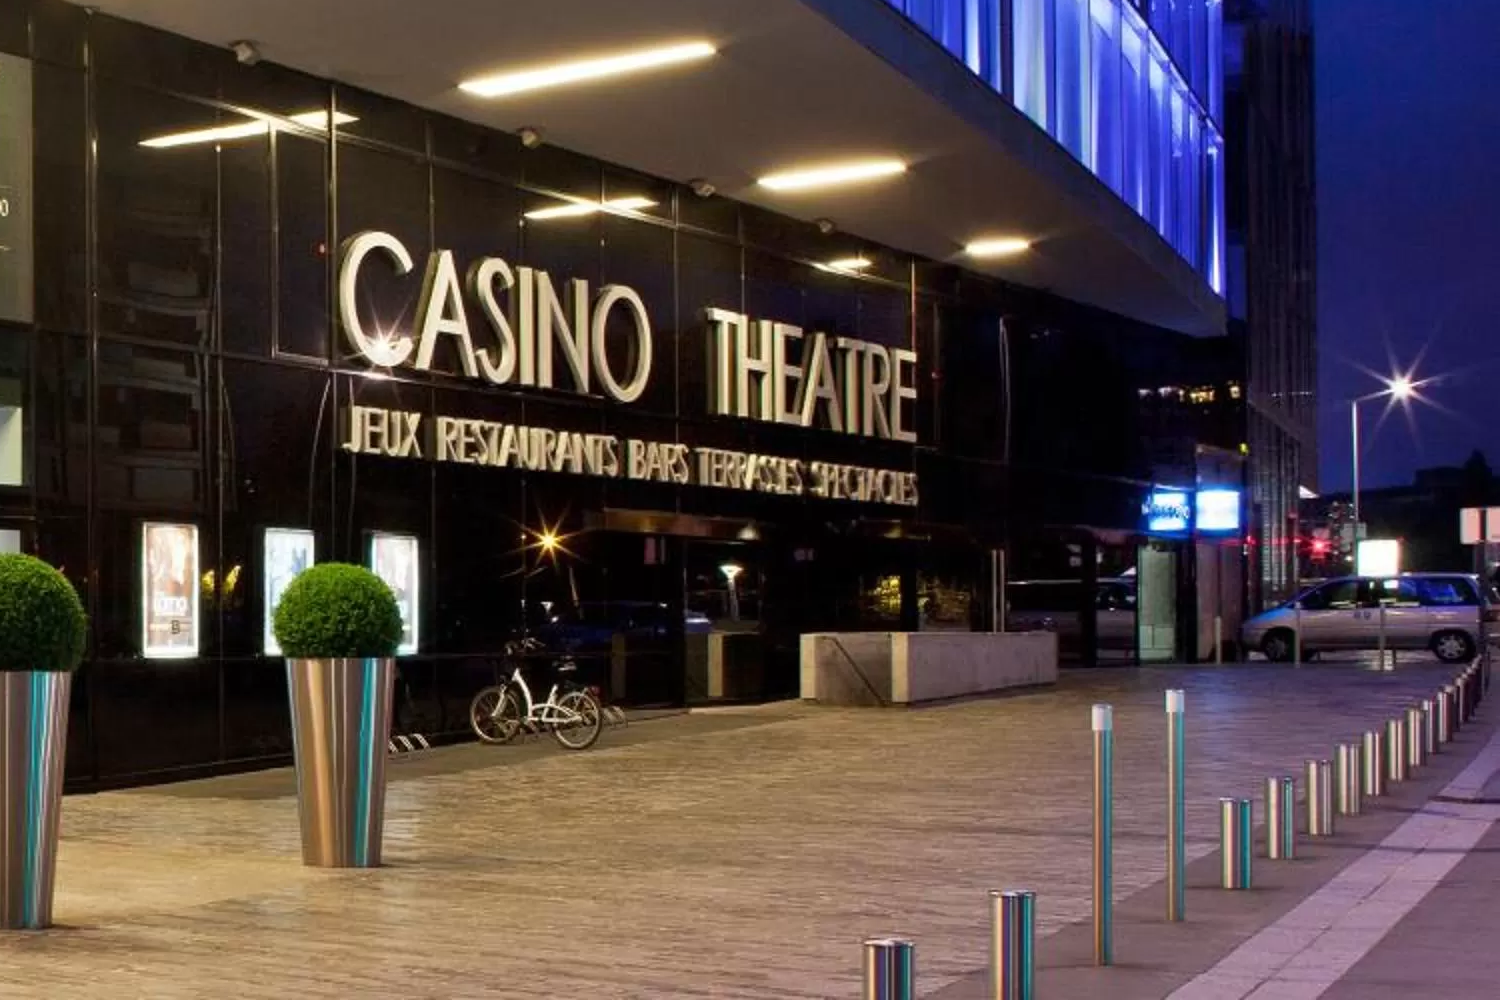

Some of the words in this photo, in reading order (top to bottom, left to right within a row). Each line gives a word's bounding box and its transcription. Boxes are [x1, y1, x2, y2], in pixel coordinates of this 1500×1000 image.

[339, 231, 652, 403] CASINO
[706, 307, 917, 442] THEATRE
[342, 405, 423, 458] JEUX
[436, 416, 619, 477] RESTAURANTS
[628, 439, 689, 484] BARS
[696, 447, 803, 495] TERRASSES
